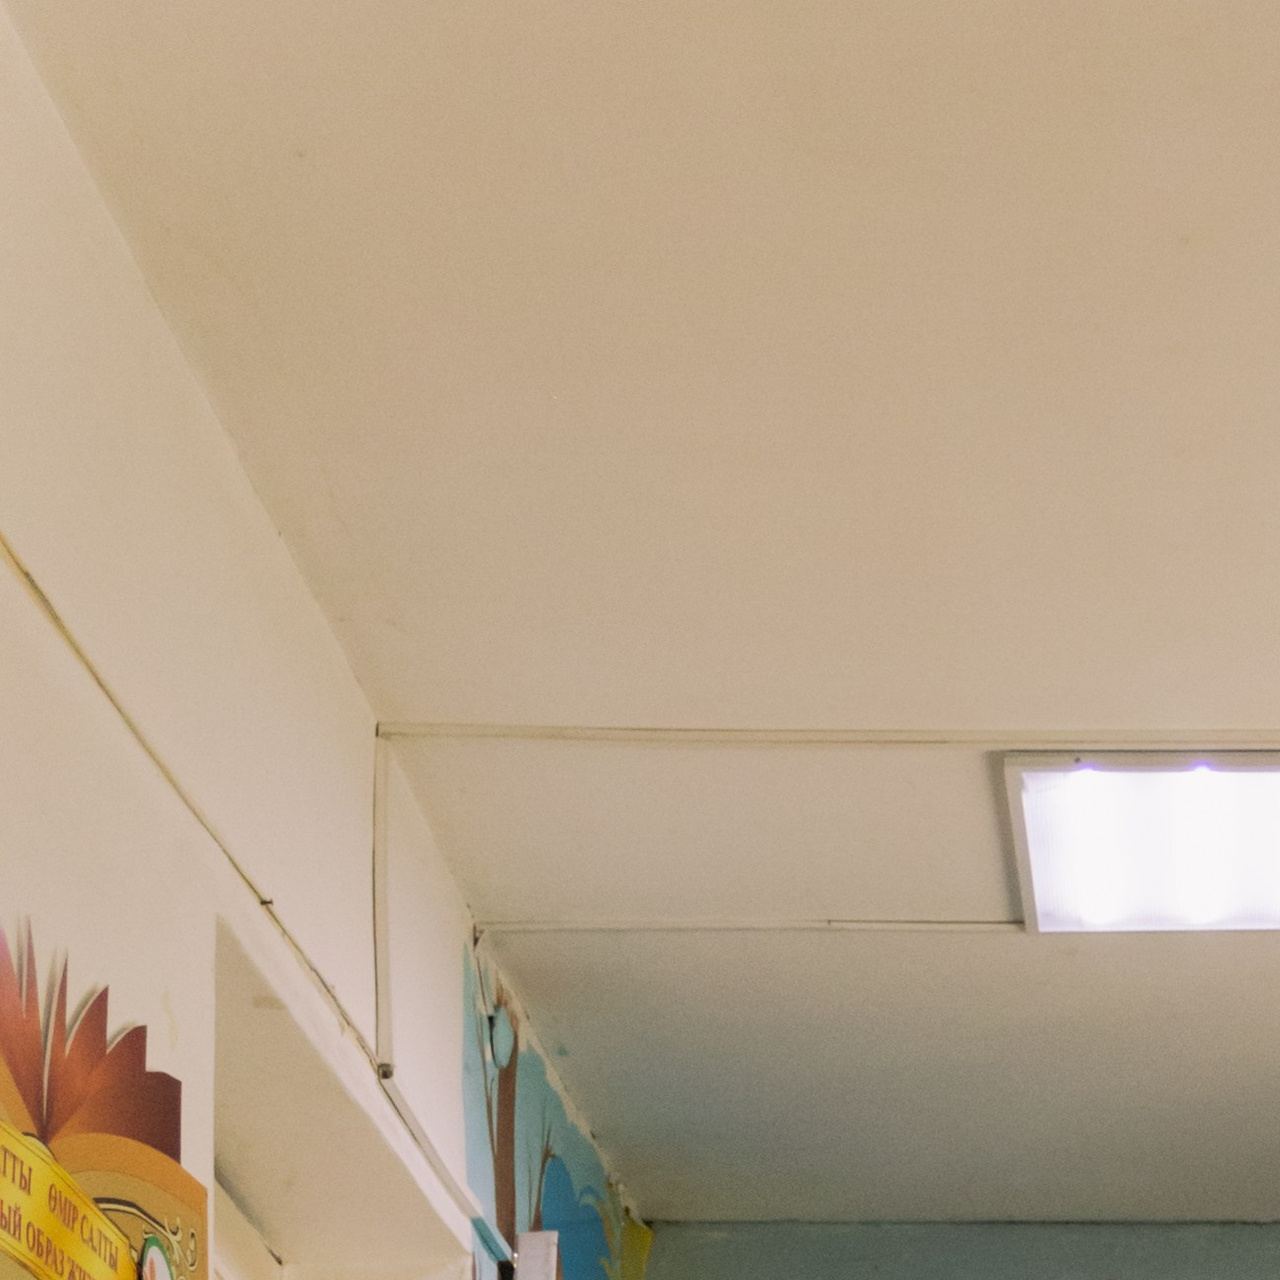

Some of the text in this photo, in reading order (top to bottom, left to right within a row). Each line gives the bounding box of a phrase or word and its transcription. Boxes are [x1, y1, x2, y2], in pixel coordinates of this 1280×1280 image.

[26, 1222, 64, 1278] ОБРАЗ
[48, 1184, 78, 1232] ӨМІР
[81, 1214, 118, 1273] САЛТЫ
